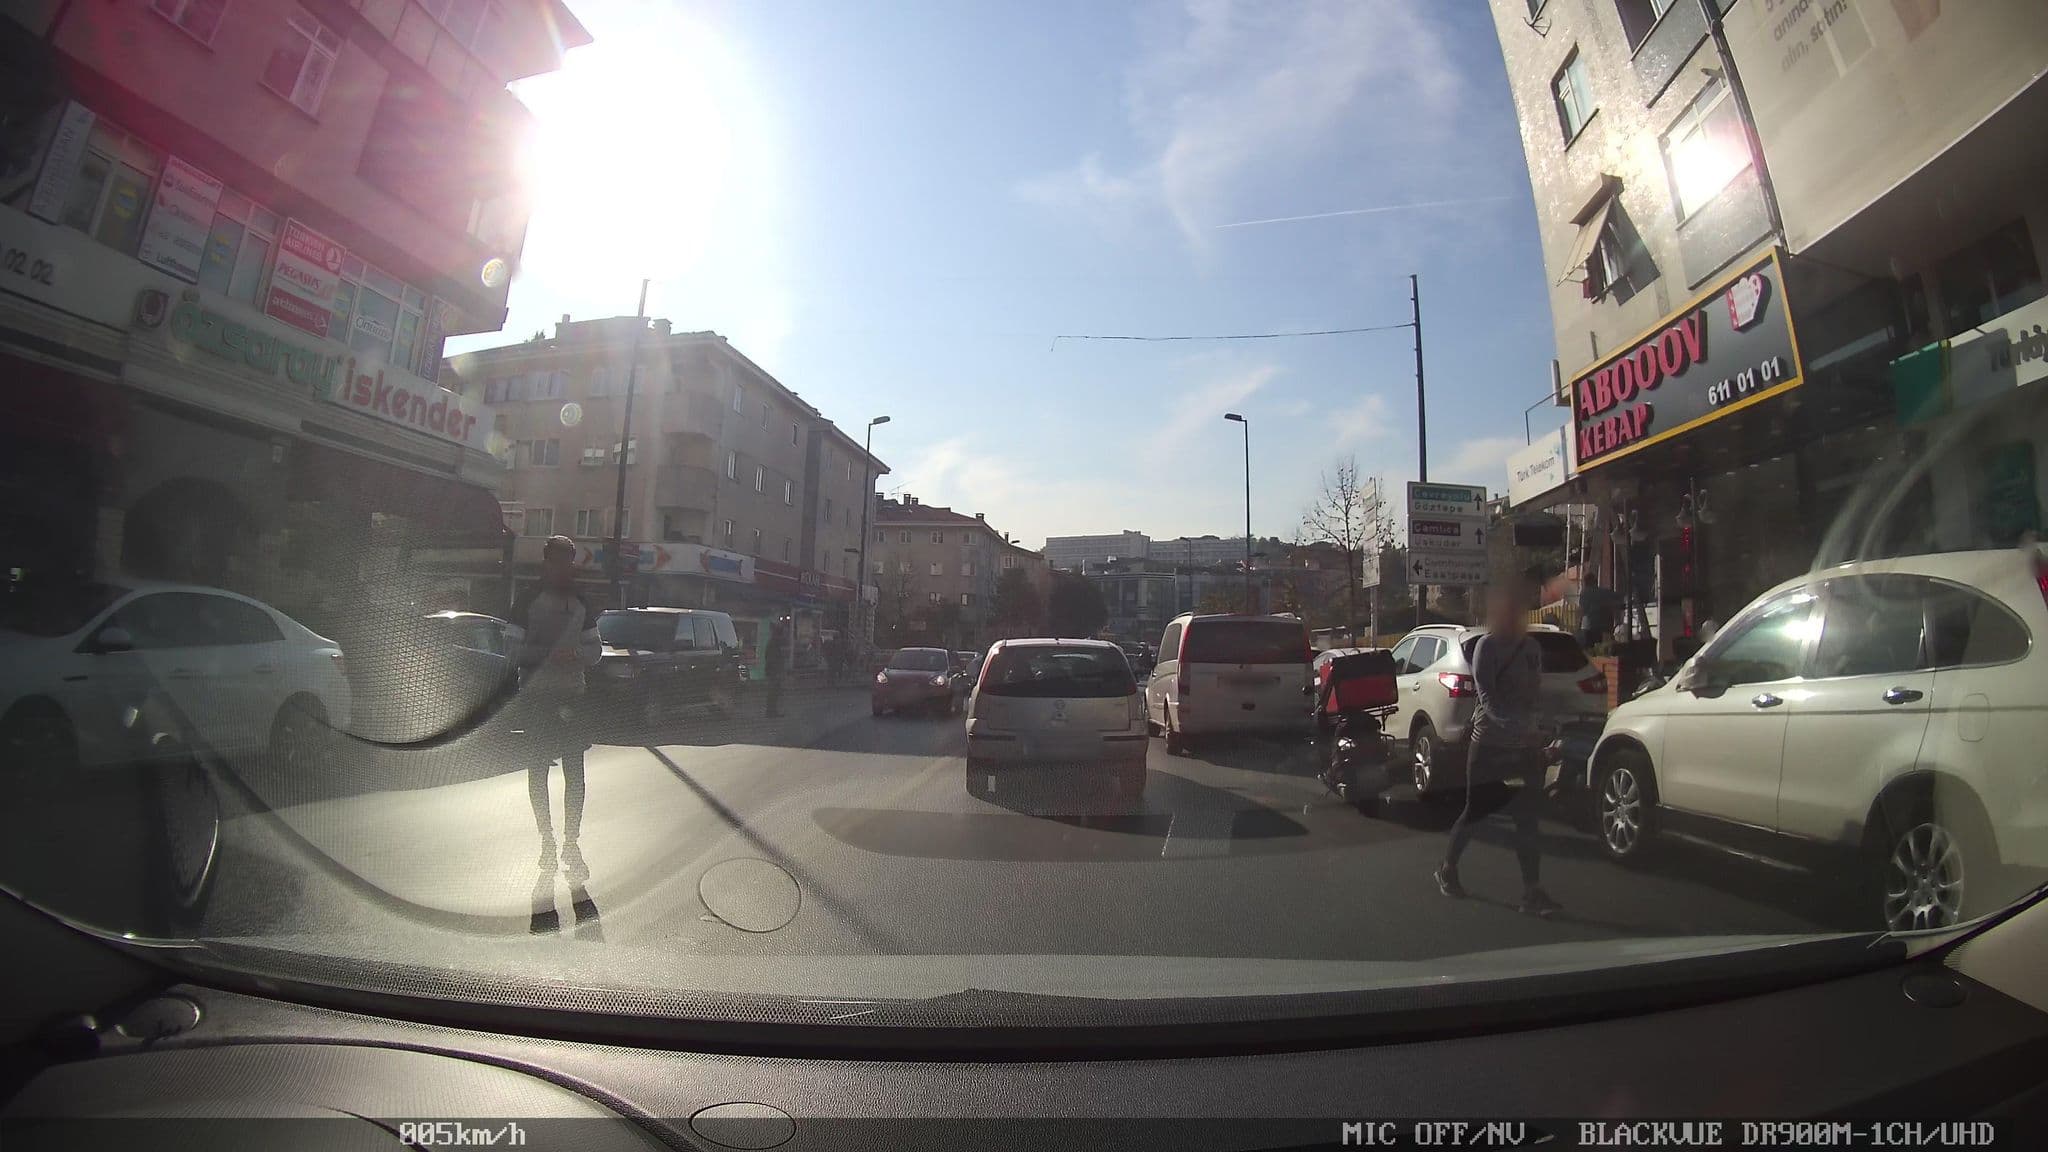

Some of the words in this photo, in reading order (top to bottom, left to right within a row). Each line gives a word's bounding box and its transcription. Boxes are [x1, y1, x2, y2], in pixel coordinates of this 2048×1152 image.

[277, 263, 322, 291] PEGASUS
[1580, 310, 1703, 422] ABOOOV
[1708, 379, 1731, 406] 611
[1736, 367, 1755, 393] 01
[1762, 356, 1781, 382] 01
[1580, 402, 1649, 459] KEBAP
